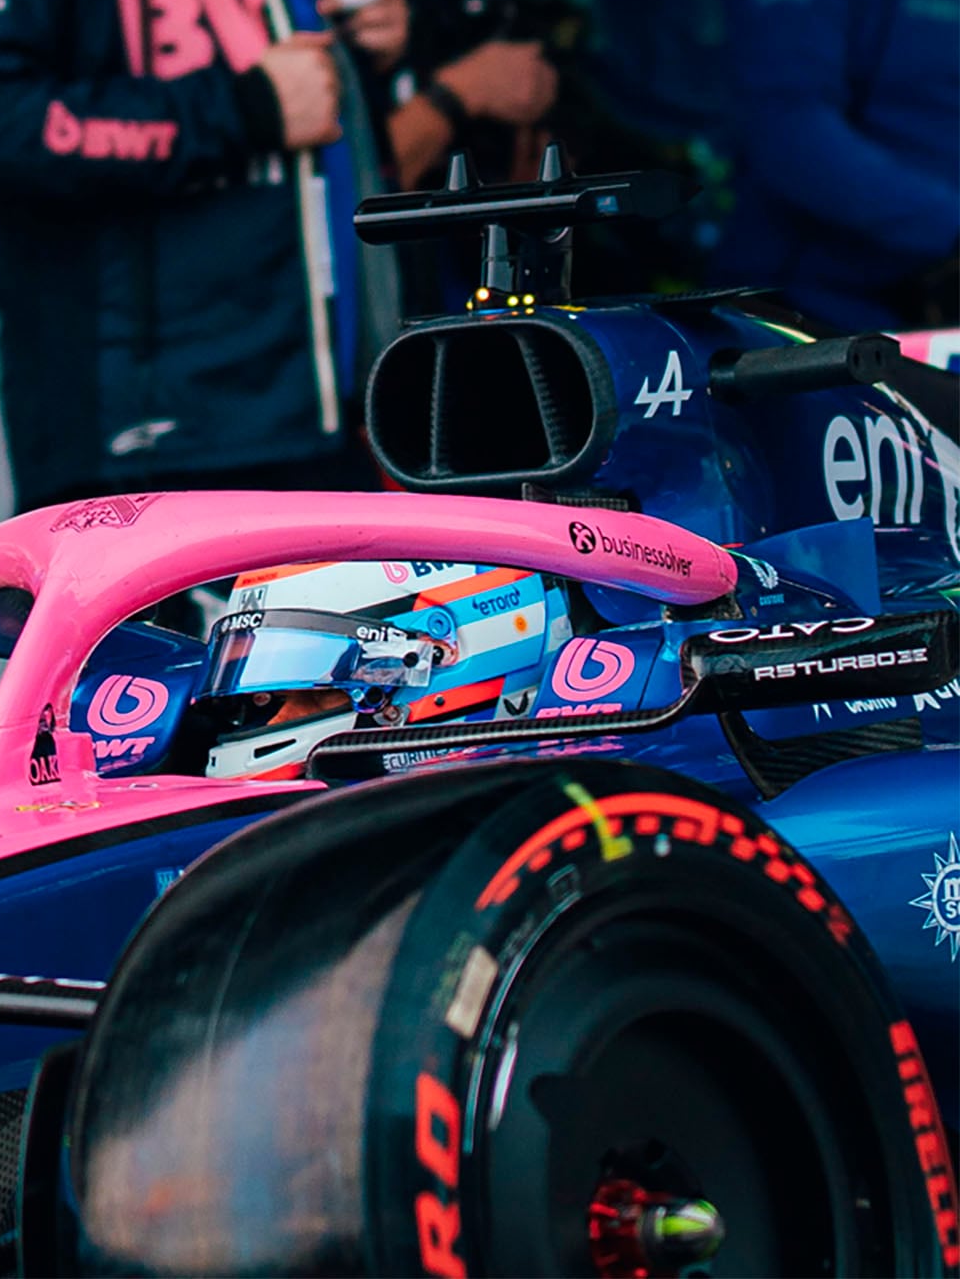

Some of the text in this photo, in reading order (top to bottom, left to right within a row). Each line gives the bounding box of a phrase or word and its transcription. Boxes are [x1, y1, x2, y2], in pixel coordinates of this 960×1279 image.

[596, 526, 693, 577] businessolver
[229, 613, 262, 630] MSC
[356, 625, 386, 642] eni
[92, 736, 156, 759] WT
